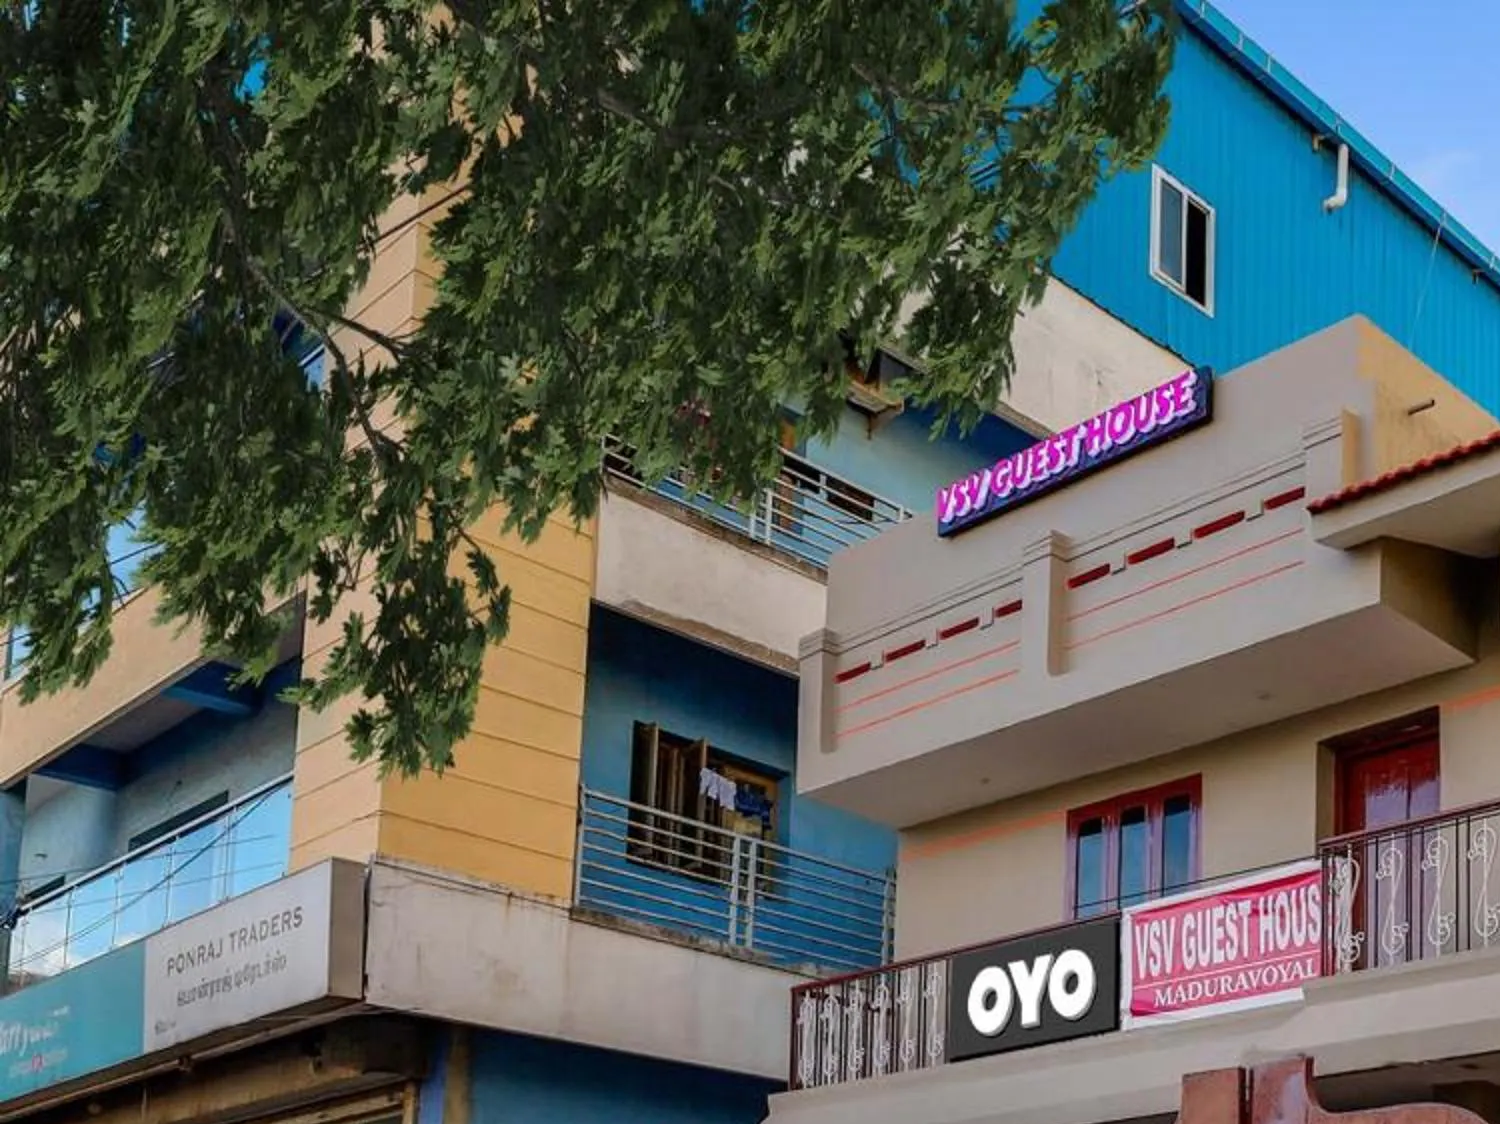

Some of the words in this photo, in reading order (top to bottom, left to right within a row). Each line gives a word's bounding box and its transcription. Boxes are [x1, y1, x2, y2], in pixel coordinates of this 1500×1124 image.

[937, 470, 991, 523] VSV
[990, 426, 1087, 498] GUEST
[1084, 369, 1198, 456] HOUSE
[166, 938, 224, 977] PONRAJ
[228, 906, 304, 952] TRADERS
[1134, 919, 1178, 979] VSV
[1180, 899, 1253, 969] GUEST
[967, 949, 1097, 1038] OYO
[1152, 958, 1318, 1009] MADURAVOYAL
